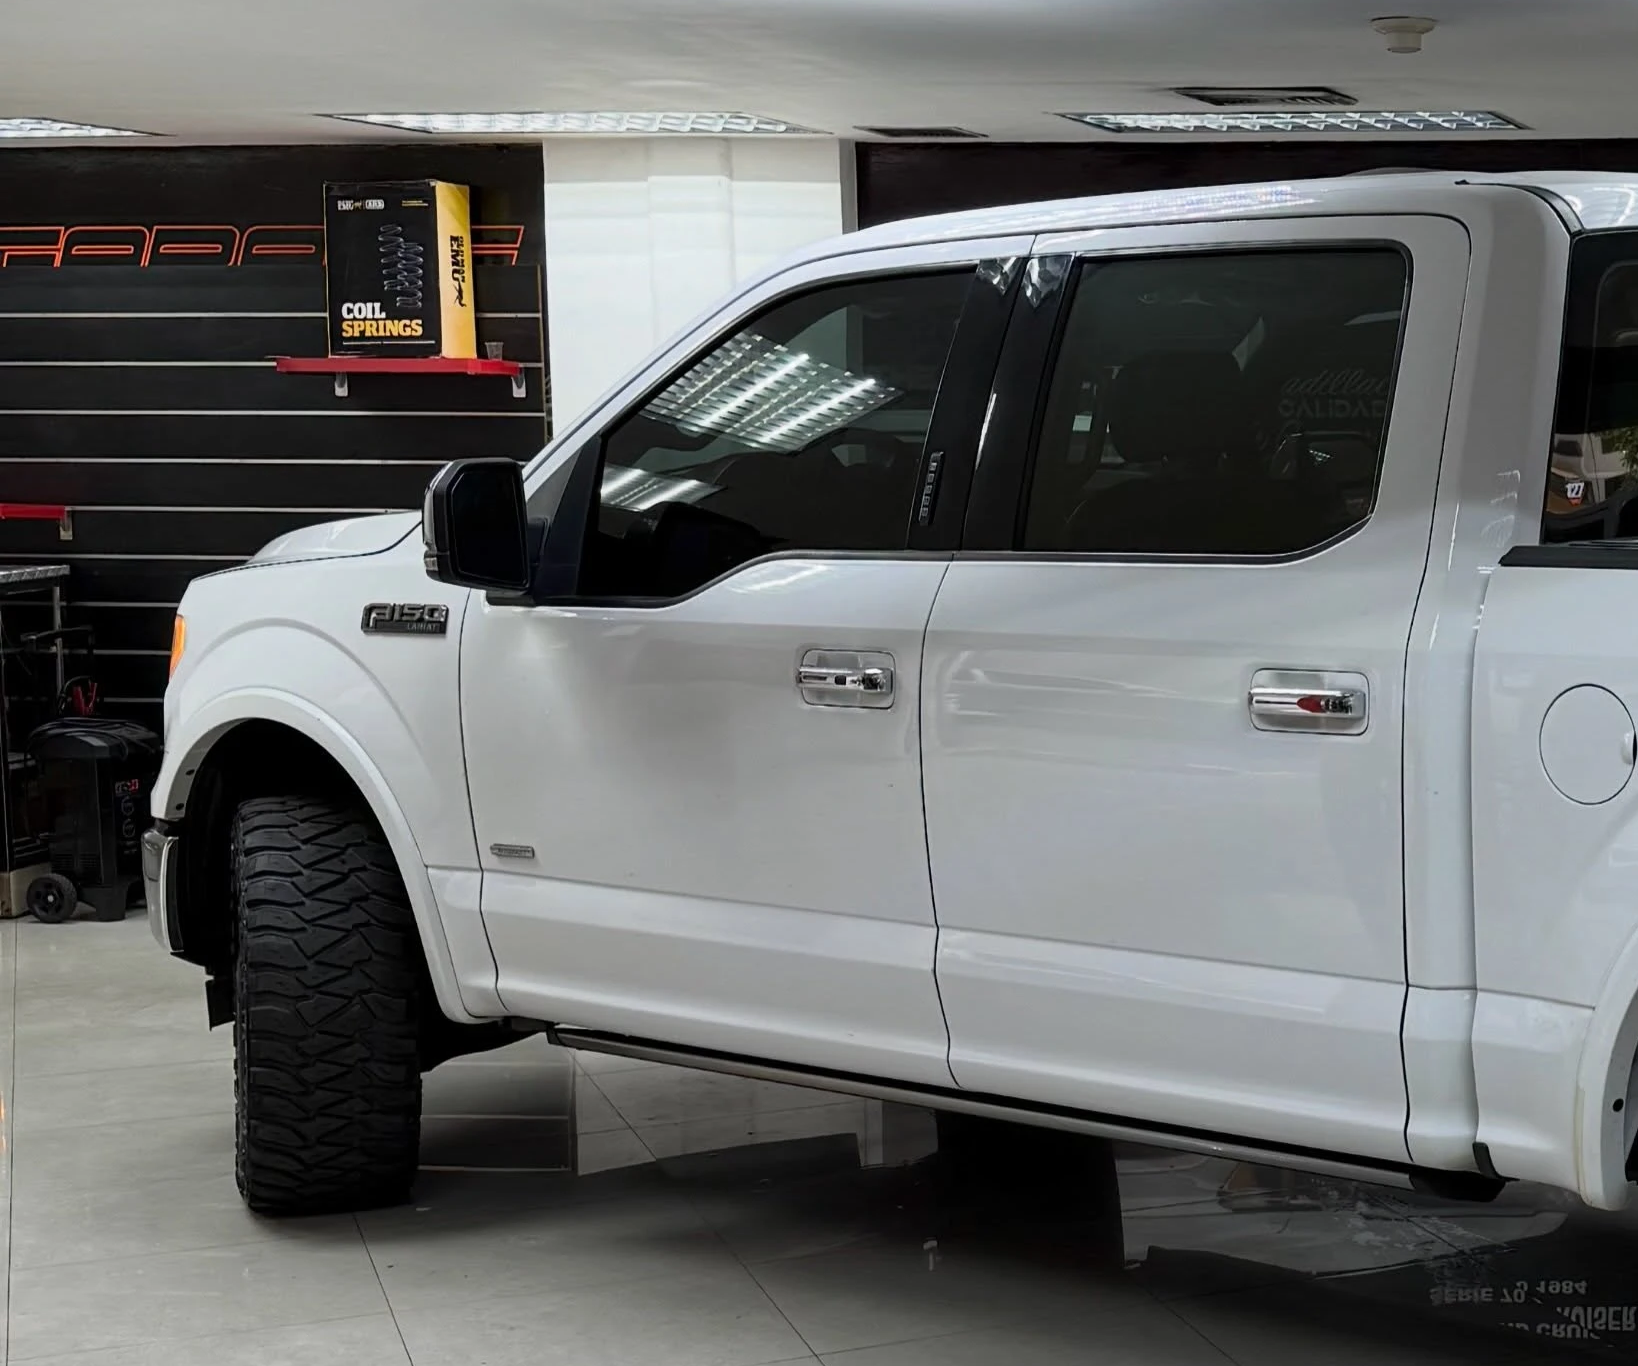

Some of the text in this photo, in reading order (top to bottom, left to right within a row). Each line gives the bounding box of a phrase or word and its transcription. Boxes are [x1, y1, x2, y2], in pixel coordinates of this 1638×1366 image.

[449, 235, 461, 282] EMU
[341, 302, 386, 319] COIL
[341, 319, 423, 337] SPRINGS
